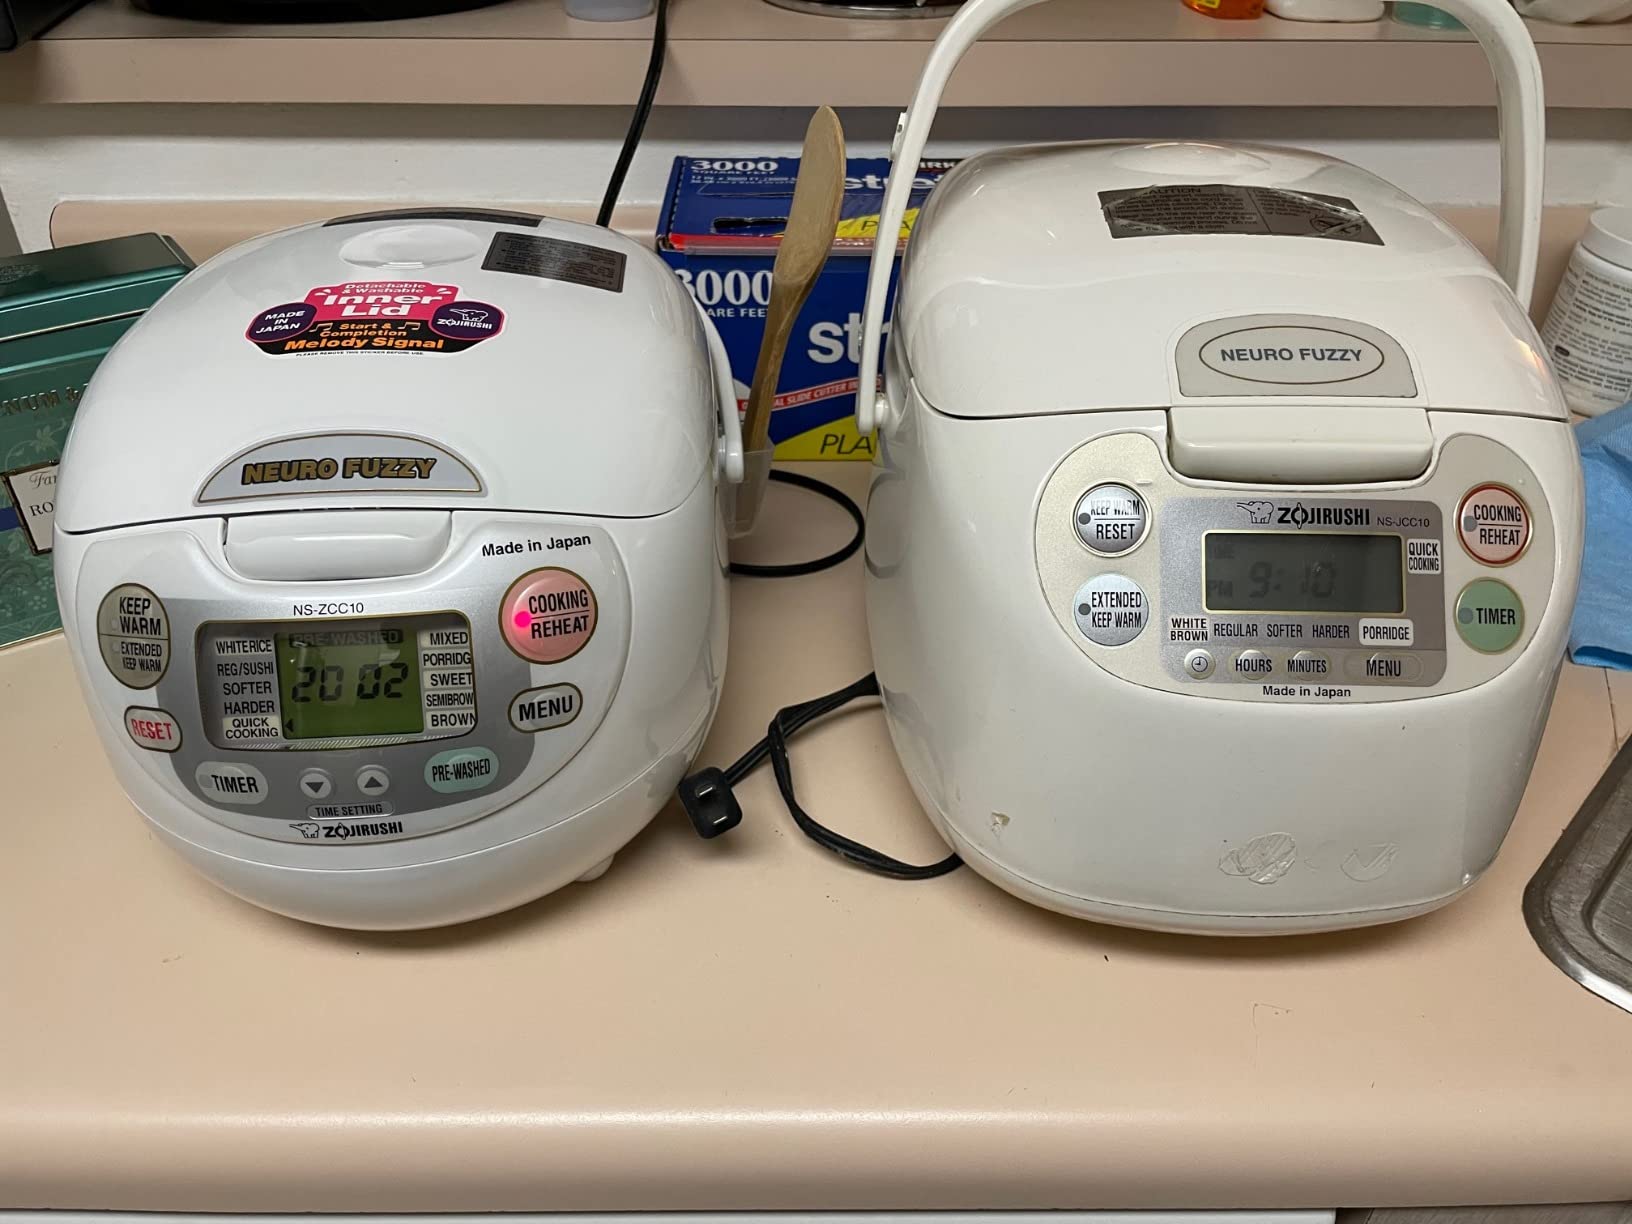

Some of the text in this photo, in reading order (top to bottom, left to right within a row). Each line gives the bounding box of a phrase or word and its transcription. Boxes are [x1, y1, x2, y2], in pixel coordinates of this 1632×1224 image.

[691, 160, 778, 171] 3000
[324, 295, 442, 305] Inner
[265, 310, 305, 321] MADE
[341, 304, 411, 317] Lid
[707, 308, 735, 317] ARE
[256, 323, 300, 334] JAPAN
[381, 322, 391, 330] &
[437, 318, 493, 329] ZOJIRUSHI
[320, 330, 407, 338] Completion
[808, 312, 889, 364] st
[284, 337, 444, 350] Melody Signal
[1221, 348, 1362, 361] NEURO FUZZY
[787, 392, 812, 405] SLIDE
[813, 383, 847, 398] CUTTER
[241, 457, 436, 485] NEURO FUZZY
[1277, 502, 1430, 530] ZOJIRUSHI NS-JCC10
[1474, 504, 1522, 522] COOKING
[1096, 524, 1135, 540] RESET
[1479, 528, 1521, 545] REHEAT
[482, 535, 591, 557] Made in Japan
[1409, 543, 1438, 556] QUICK
[1409, 557, 1439, 571] COOKING
[119, 597, 150, 615] KEEP
[529, 589, 589, 614] COOKING
[1091, 591, 1142, 608] EXTENDED
[293, 602, 364, 616] NS-ZCC10
[1476, 607, 1516, 625] TIMER
[119, 616, 161, 635] WARM
[531, 615, 589, 639] REHEAT
[1092, 611, 1142, 629] KEEP WARM
[1171, 618, 1207, 629] WHITE
[1170, 630, 1208, 641] BROWN
[1214, 624, 1350, 638] REGULAR SOFTER HARDER
[1363, 626, 1410, 640] PORRIDGE
[430, 632, 468, 645] MIXED
[121, 641, 162, 657] EXTENDED
[123, 658, 162, 672] KEEP WARM
[423, 652, 471, 666] PORRIDG
[1235, 659, 1272, 672] HOURS
[1287, 659, 1327, 673] MINUTES
[1366, 660, 1401, 677] MENU
[430, 672, 472, 686] SWEET
[223, 681, 272, 695] SOFTER
[1262, 685, 1351, 699] Made in Japan
[427, 693, 474, 707] SEMIBROW
[224, 701, 275, 714] HARDER
[519, 695, 573, 721] MENU
[232, 717, 269, 728] QUICK
[431, 713, 476, 727] BROWN
[131, 719, 172, 740] RESET
[226, 728, 278, 739] COOKING
[432, 758, 490, 782] PRE-WASHED
[211, 774, 259, 793] TIMER
[315, 804, 382, 818] TIME SETTING
[322, 821, 403, 841] ZOJIRUSHI
